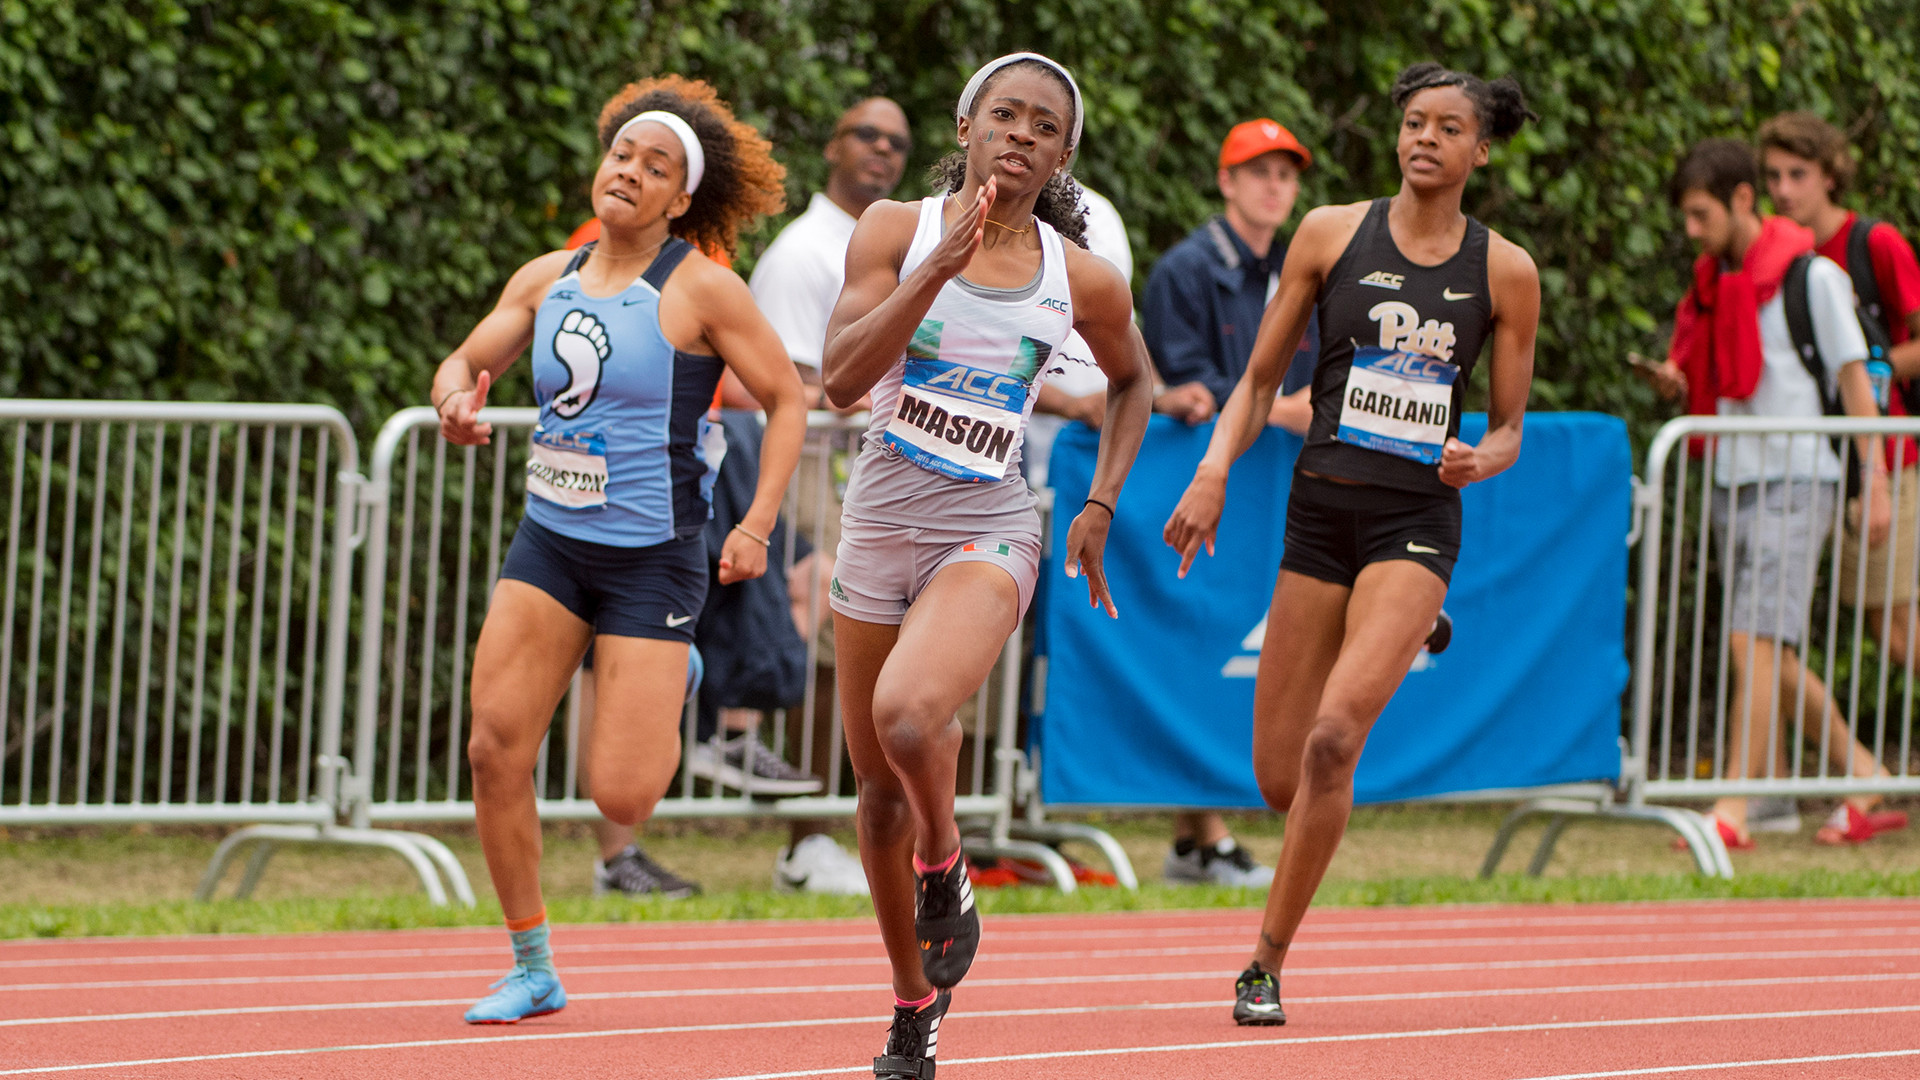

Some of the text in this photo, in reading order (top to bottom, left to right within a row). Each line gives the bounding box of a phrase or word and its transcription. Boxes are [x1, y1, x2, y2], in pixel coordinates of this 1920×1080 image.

[1363, 270, 1405, 288] ACC
[1039, 297, 1069, 313] ACC
[1368, 301, 1457, 362] Pitt
[1373, 351, 1449, 377] ACC
[926, 366, 1019, 402] ACC
[1349, 386, 1447, 426] GARLAND
[897, 394, 1015, 464] MASON
